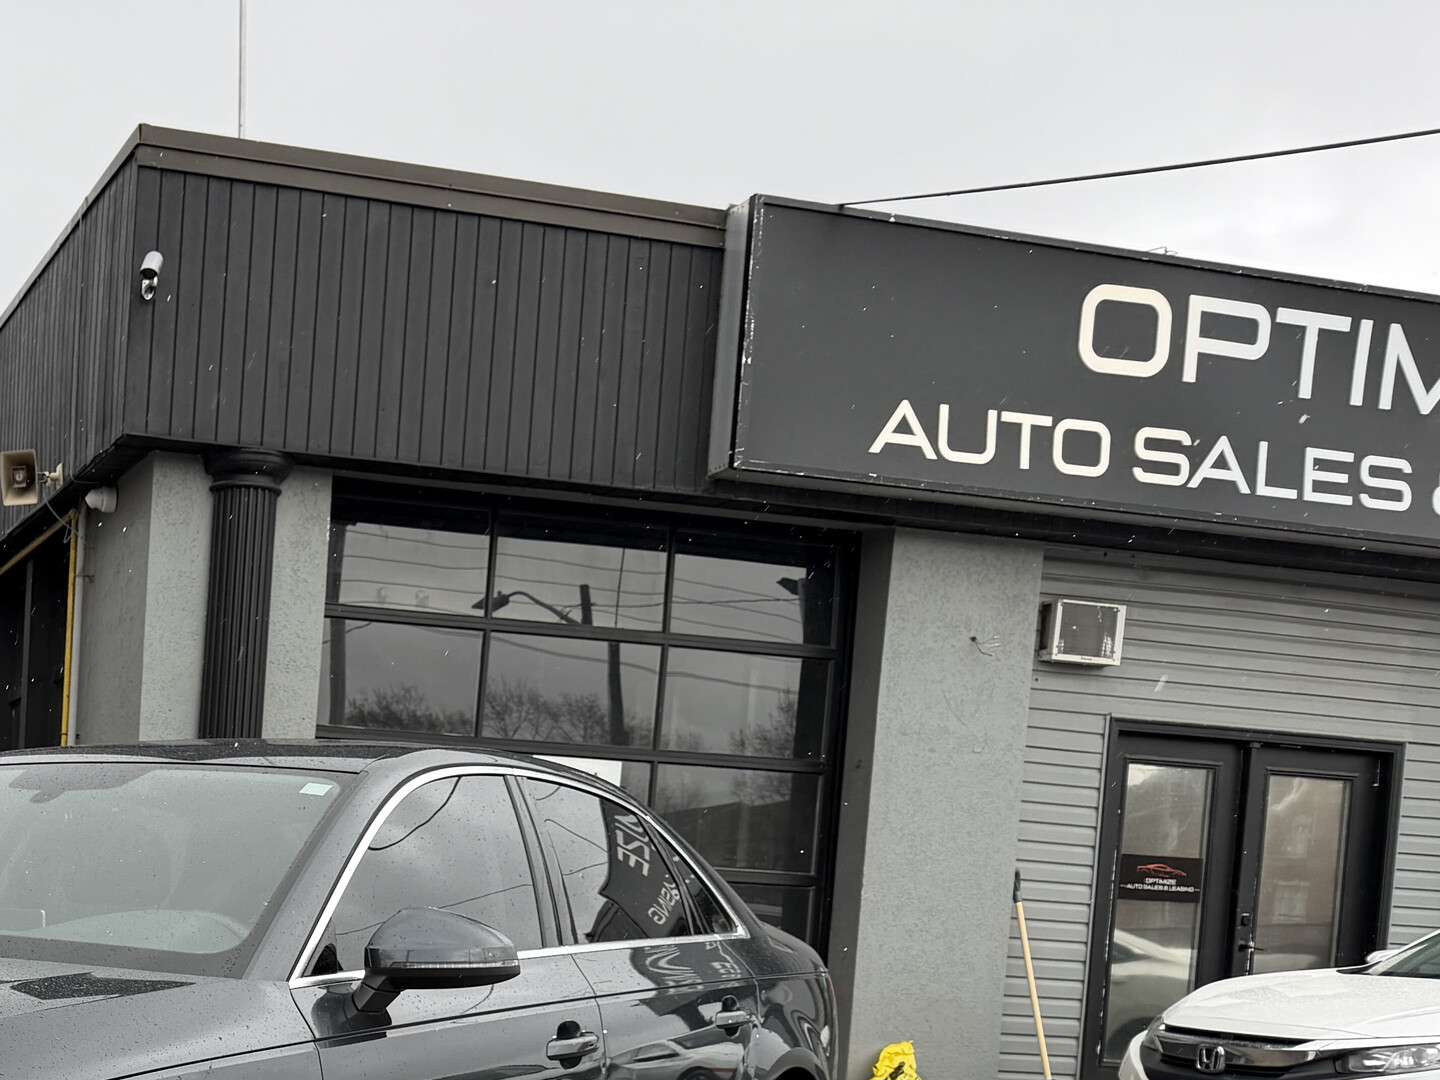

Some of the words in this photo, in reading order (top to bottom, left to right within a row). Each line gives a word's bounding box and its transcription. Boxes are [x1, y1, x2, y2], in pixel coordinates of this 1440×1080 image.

[1078, 283, 1440, 415] OPTIM
[868, 399, 1112, 478] AUTO
[1132, 426, 1413, 512] SALES
